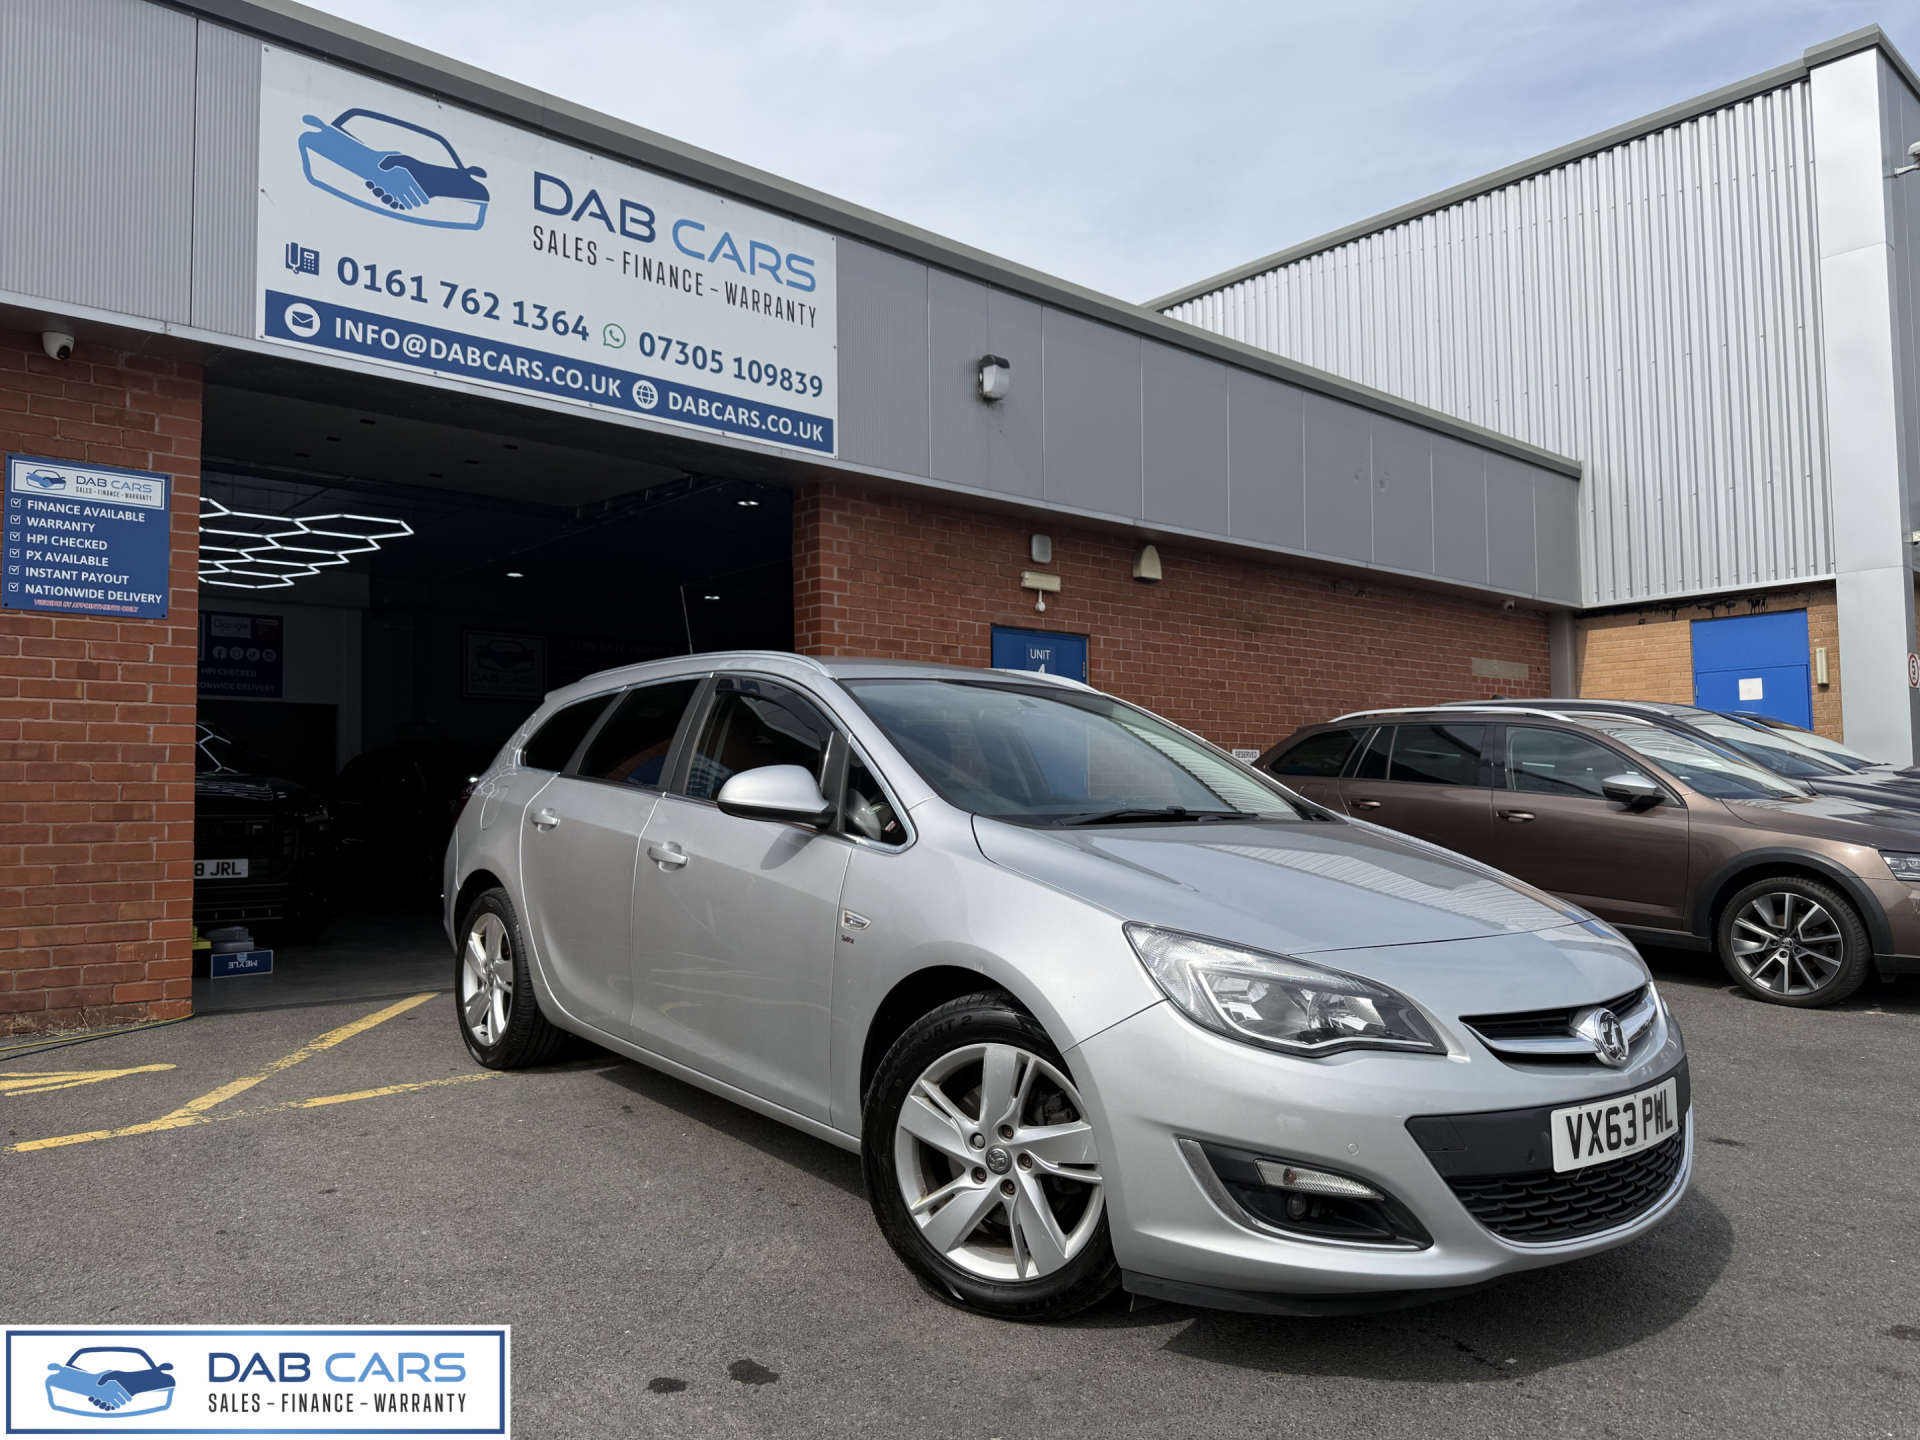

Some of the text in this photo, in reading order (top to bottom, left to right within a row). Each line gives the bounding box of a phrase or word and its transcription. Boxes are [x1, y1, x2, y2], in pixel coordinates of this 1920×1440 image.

[534, 171, 816, 292] DAB CARS
[533, 225, 597, 266] SALES
[623, 251, 703, 296] FINANCE
[725, 281, 817, 328] WARRANTY
[337, 256, 589, 342] 0161 762 1364
[335, 317, 622, 399] INFO@DABCARS.CO.UK
[639, 332, 823, 398] 07305 109839
[668, 391, 823, 443] DABCARS.CO.UK
[76, 475, 153, 493] DAB CARS
[27, 500, 145, 522] FINANCE AVAILABLE
[27, 517, 95, 532] WARRANTY
[27, 533, 108, 550] HPI CHECKED
[26, 550, 109, 567] PX AVAILABLE
[25, 567, 130, 585] INSTANT PAYOUT
[25, 584, 162, 604] NATIONWIDE DELIVERY
[1030, 648, 1051, 660] UNIT
[210, 862, 242, 876] JRL
[228, 960, 258, 969] MEYLE
[1565, 1102, 1637, 1160] VX63
